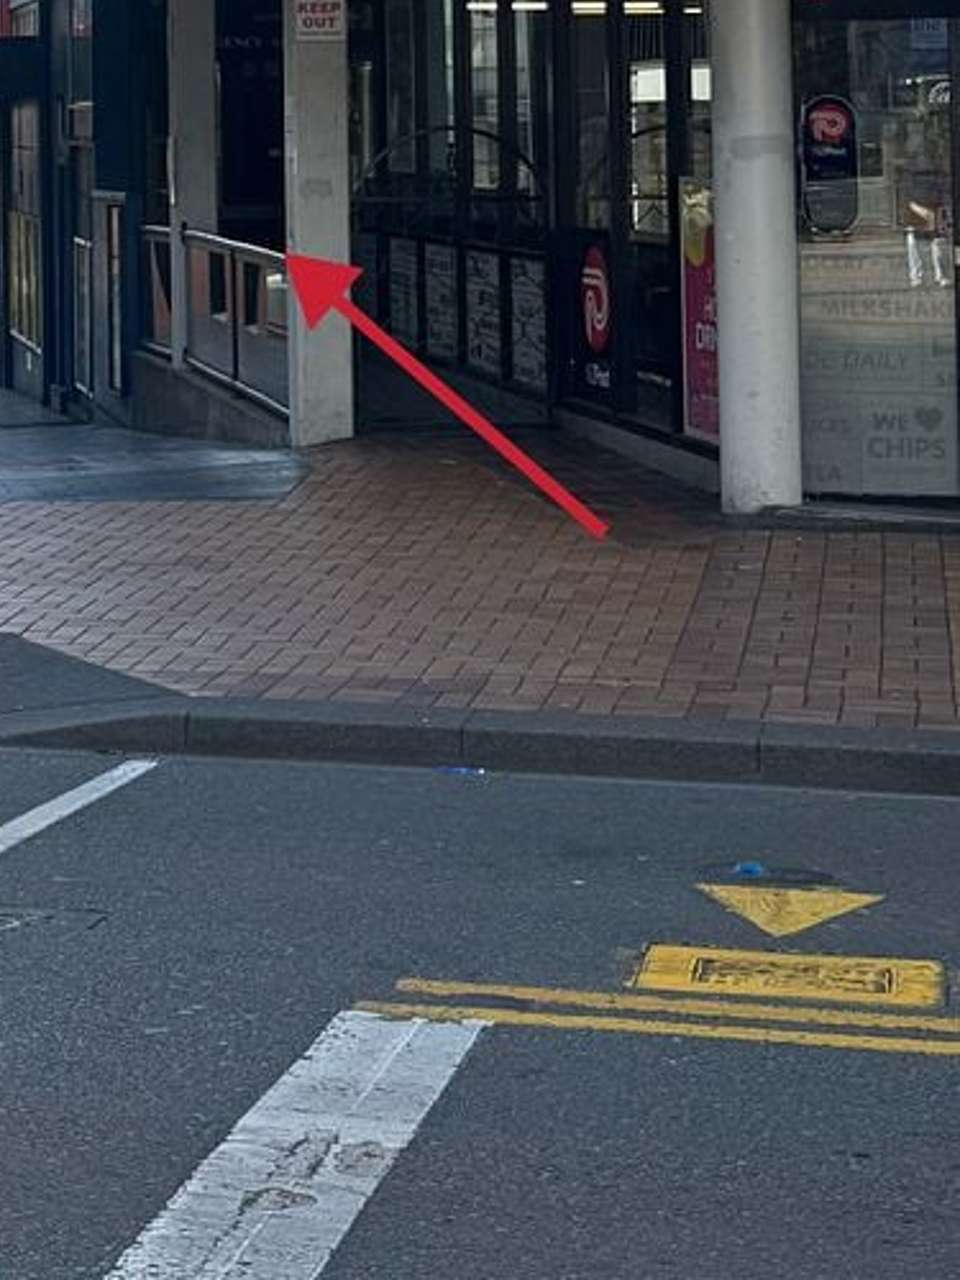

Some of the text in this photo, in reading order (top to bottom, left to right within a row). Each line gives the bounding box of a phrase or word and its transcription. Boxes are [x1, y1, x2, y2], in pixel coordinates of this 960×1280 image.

[296, 1, 342, 14] KEEP
[302, 17, 336, 29] OUT
[871, 411, 908, 431] WE
[866, 436, 946, 460] CHIPS
